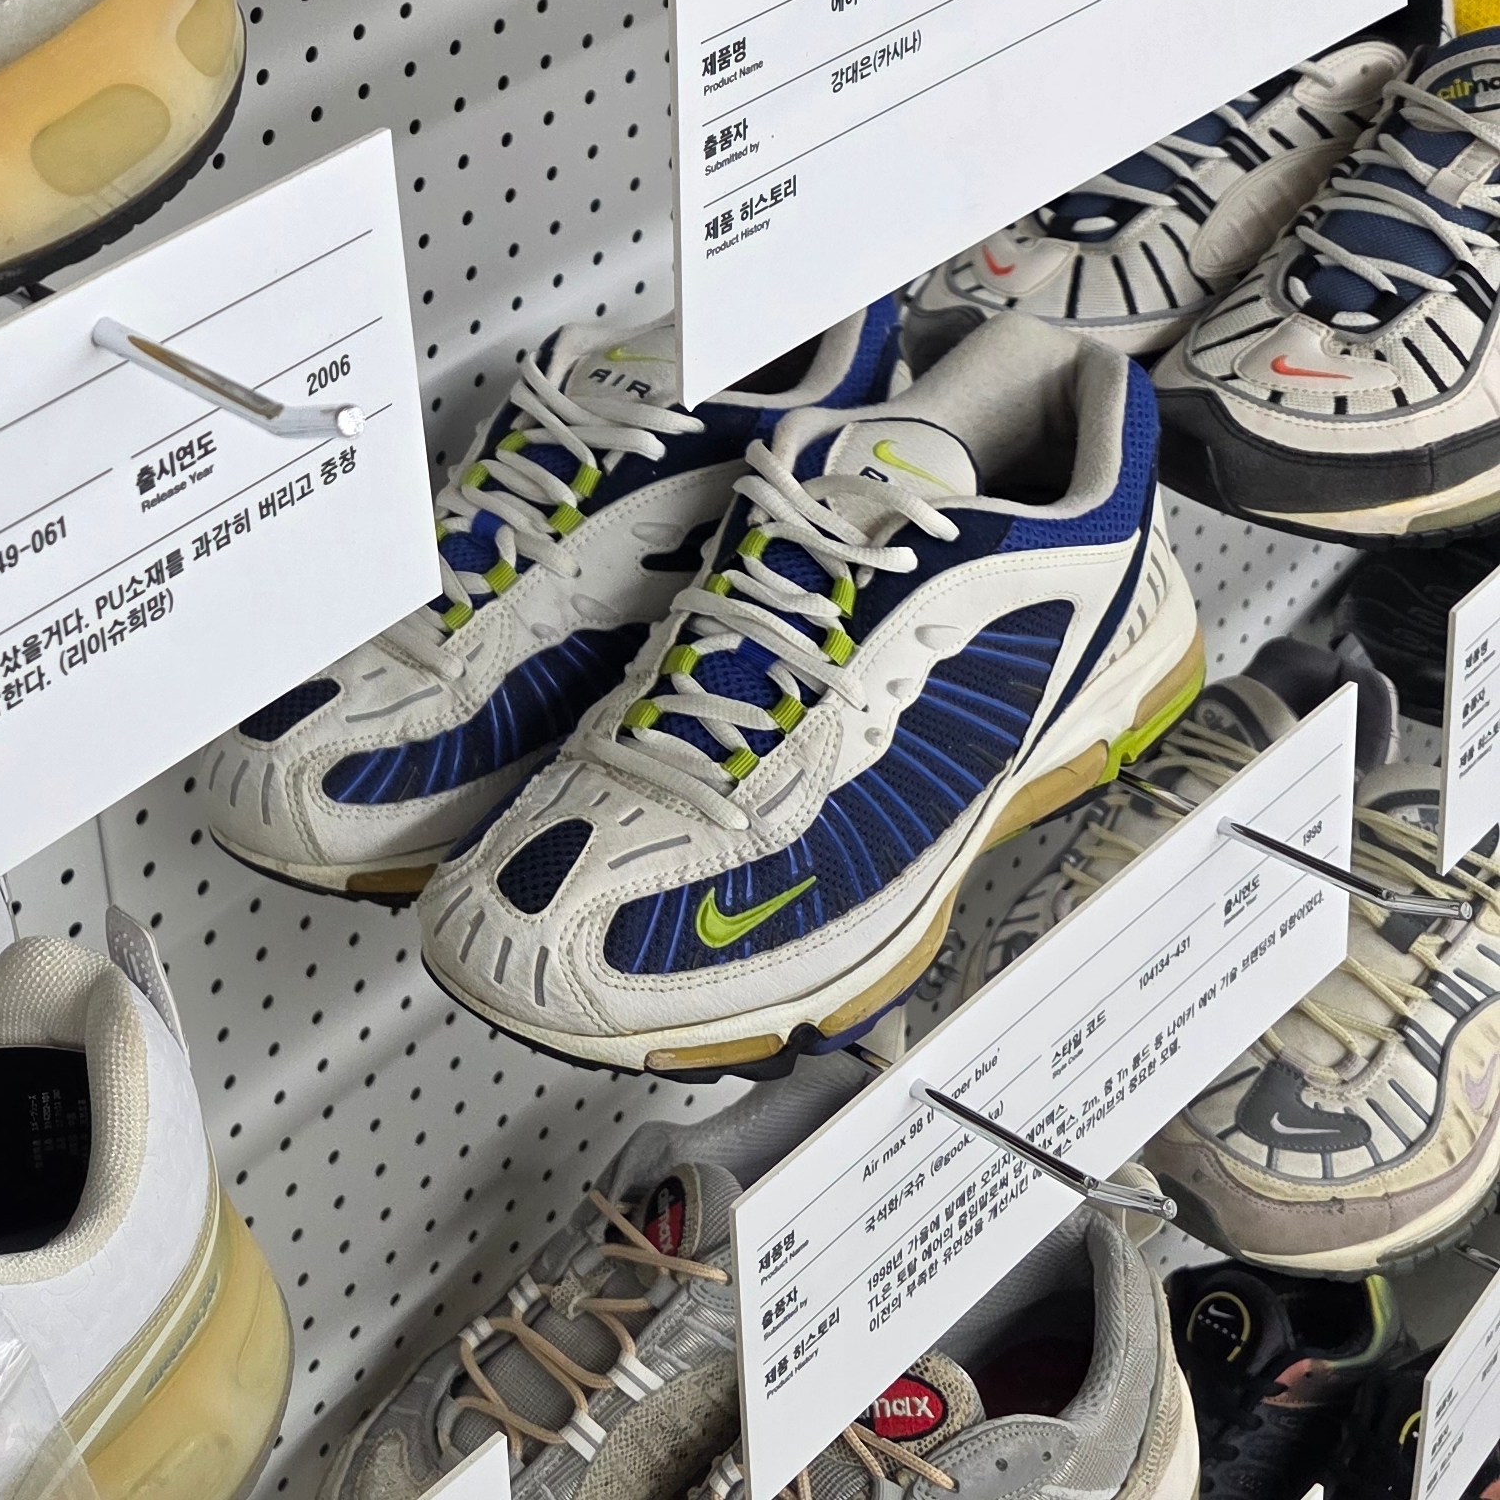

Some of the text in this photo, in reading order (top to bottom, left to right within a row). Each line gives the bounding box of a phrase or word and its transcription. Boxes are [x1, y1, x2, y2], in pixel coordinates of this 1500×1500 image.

[701, 36, 747, 77] 제품명
[703, 59, 764, 96] Product Name
[831, 29, 922, 94] 강대은(카시나)
[704, 117, 749, 160] 출품자
[704, 141, 760, 176] Submitted by
[704, 174, 797, 242] 제품 히스토리
[706, 217, 771, 259] Product History
[306, 354, 352, 396] 2006
[587, 367, 652, 399] AIR
[134, 431, 217, 496] 출시연도
[140, 464, 215, 513] Release Year
[0, 611, 90, 678] 샀을거다.
[95, 550, 184, 621] PU소재를
[192, 508, 251, 562] 과감히
[257, 474, 314, 522] 버리고
[320, 446, 358, 486] 중창
[58, 586, 174, 676] (리이슈희망)
[1303, 820, 1323, 847] 1998
[1138, 935, 1191, 990] 104134-431
[1051, 1009, 1107, 1069] 스타일 코드
[867, 1284, 891, 1313] TL은
[896, 1260, 918, 1285] 토탈
[921, 1229, 954, 1264] 에어의
[957, 1171, 1009, 1231] 줄임말로써
[1115, 1065, 1129, 1083] Tn
[1153, 1032, 1164, 1051] 등
[1166, 1006, 1195, 1040] 나이키
[1198, 984, 1217, 1009] 에어
[1220, 967, 1238, 992] 기술
[1241, 930, 1276, 970] 브랜딩의
[862, 1161, 880, 1182] Air
[882, 1135, 907, 1163] max
[909, 1119, 924, 1141] 98
[865, 1171, 926, 1234] 국석화/국슈
[867, 1252, 903, 1292] 1998년
[907, 1219, 941, 1251] 가을에
[944, 1189, 977, 1224] 발매한
[980, 1152, 1017, 1194] 오리지
[868, 1297, 901, 1332] 이전의
[906, 1264, 939, 1298] 부족한
[943, 1224, 984, 1265] 유연성을
[987, 1177, 1029, 1222] 개선시킨
[1075, 1090, 1125, 1140] 아카이브의
[1128, 1061, 1157, 1093] 중요한
[757, 1229, 796, 1273] 제품명
[761, 1286, 799, 1330] 출품자
[764, 1307, 840, 1387] 제품 히스토리
[860, 1394, 935, 1420] max
